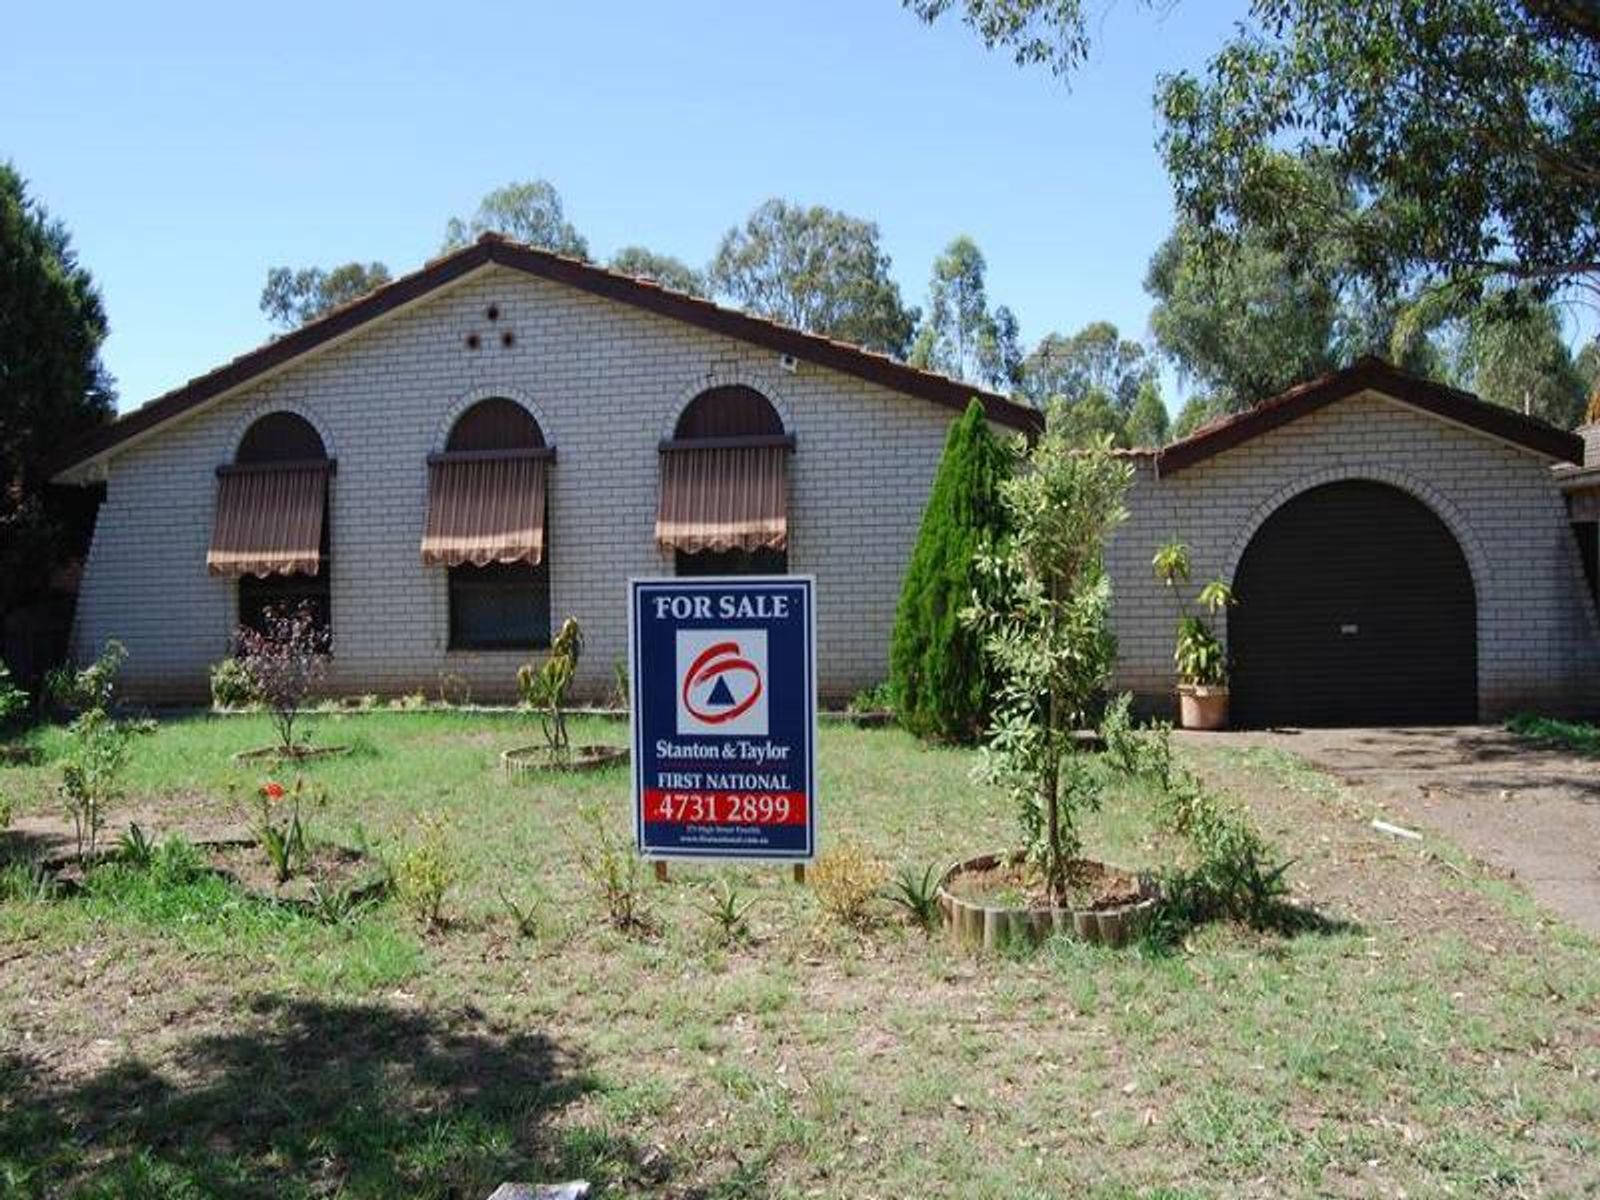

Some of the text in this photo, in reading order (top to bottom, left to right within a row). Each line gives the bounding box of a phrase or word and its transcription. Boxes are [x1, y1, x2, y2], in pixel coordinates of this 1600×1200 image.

[656, 594, 789, 619] FOR SALE
[656, 739, 790, 765] Stanton & Taylor
[657, 772, 791, 789] FIRST NATIONAL
[659, 794, 790, 822] 4731 2899
